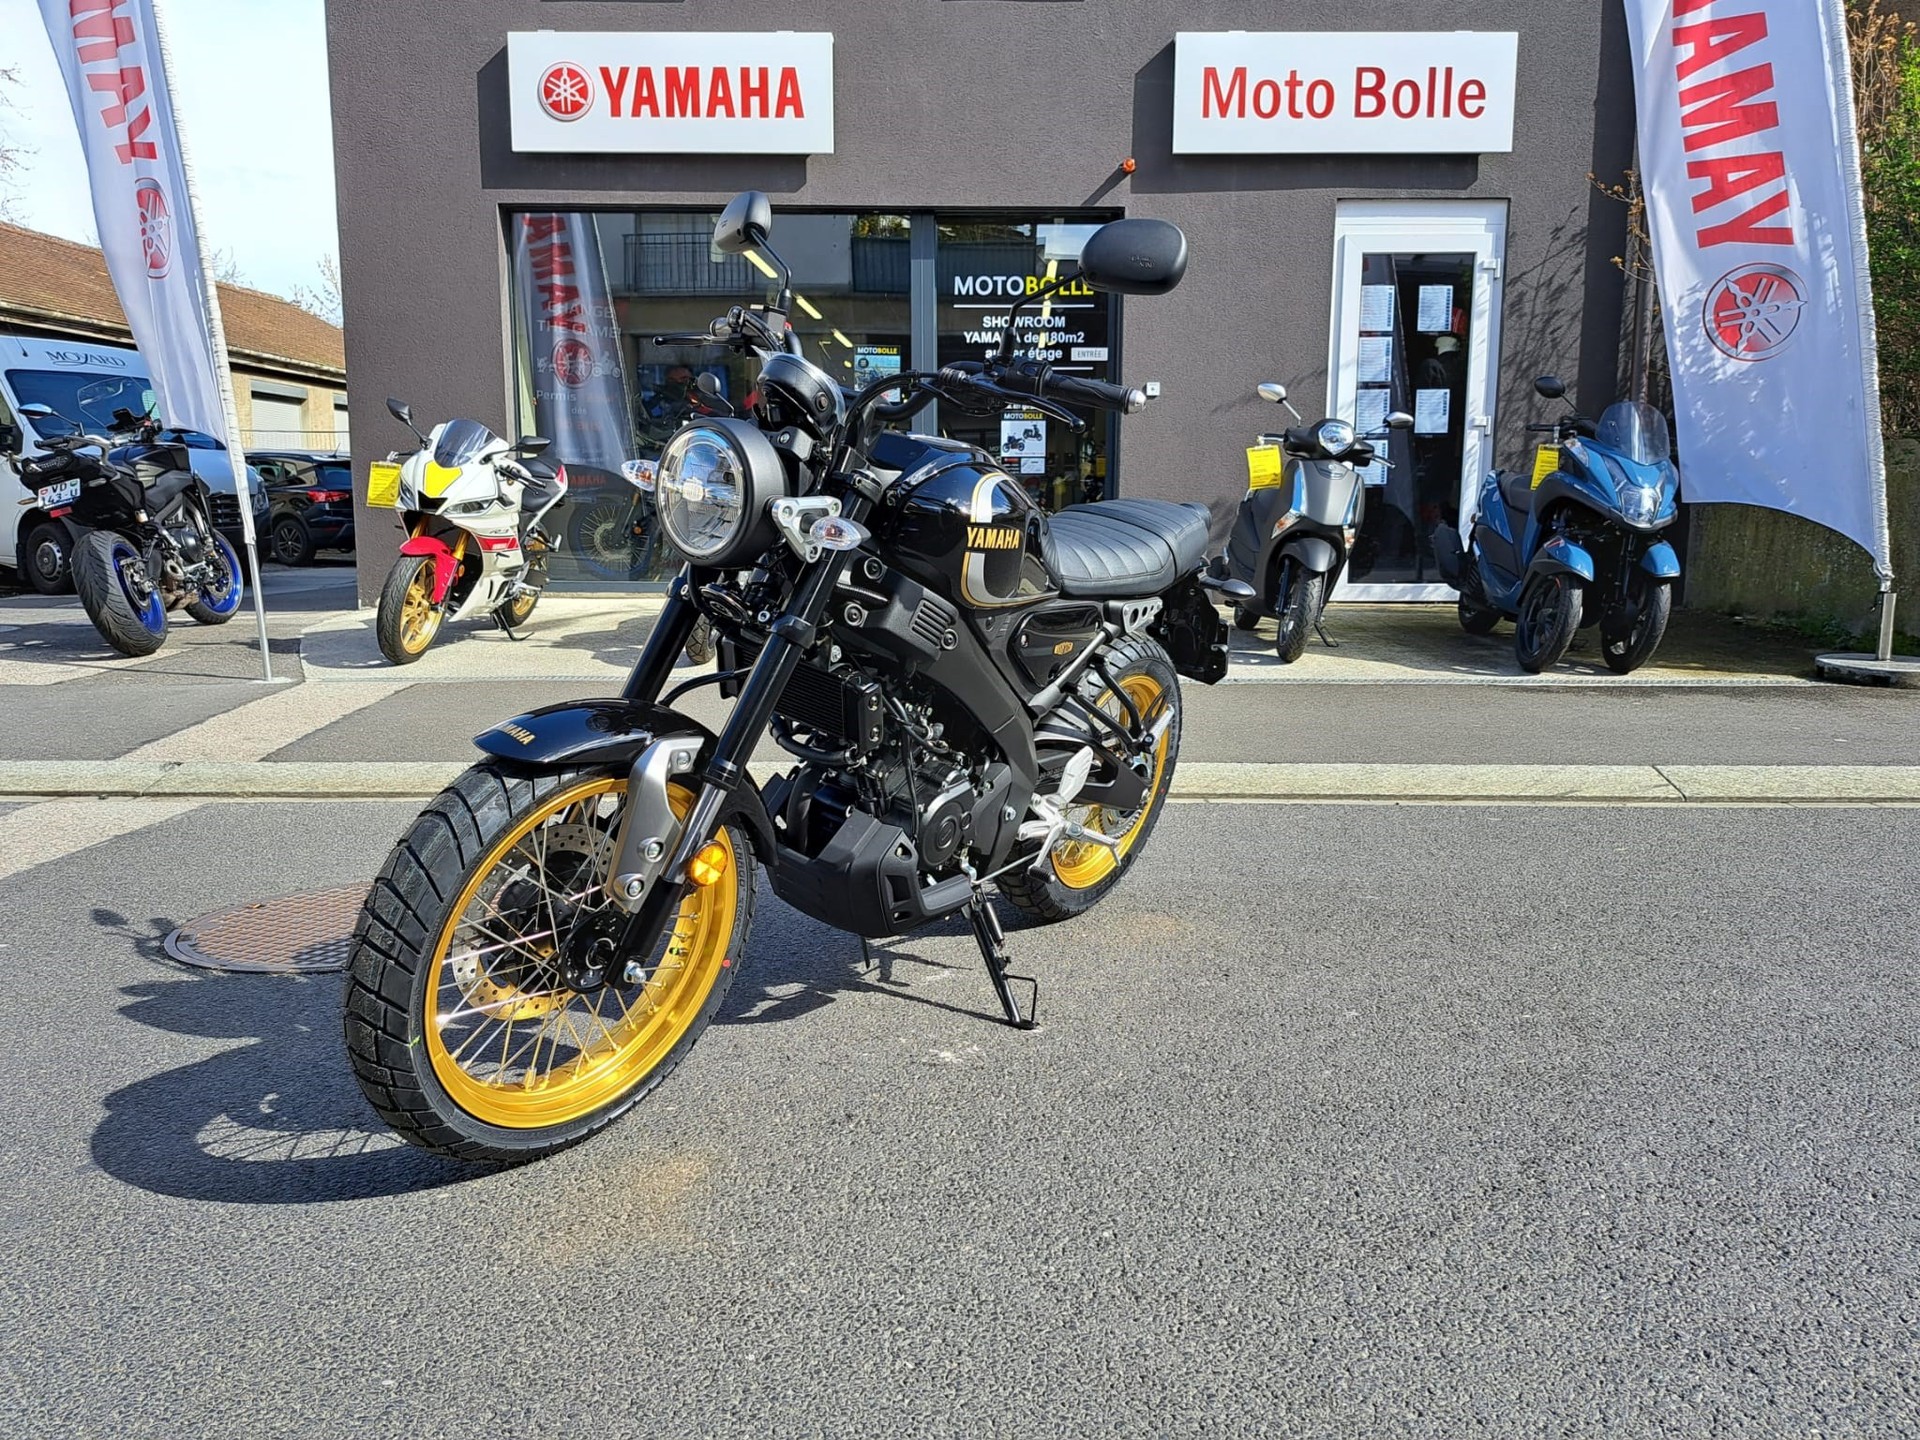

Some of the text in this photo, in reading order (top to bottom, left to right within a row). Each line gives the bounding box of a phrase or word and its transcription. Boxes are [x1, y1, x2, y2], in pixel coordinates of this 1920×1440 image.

[598, 66, 805, 119] YAMAHA
[1202, 66, 1487, 120] Moto Bolle
[982, 315, 1066, 328] SHOWROOM
[963, 331, 1021, 344] YAMA
[1024, 331, 1039, 344] de
[857, 346, 898, 354] MOTOBOLLE
[1028, 346, 1063, 362] étage
[536, 390, 577, 401] Permis
[1003, 412, 1044, 420] MOTOBOLLE
[52, 482, 68, 493] VD
[966, 526, 1020, 549] YAMAHA
